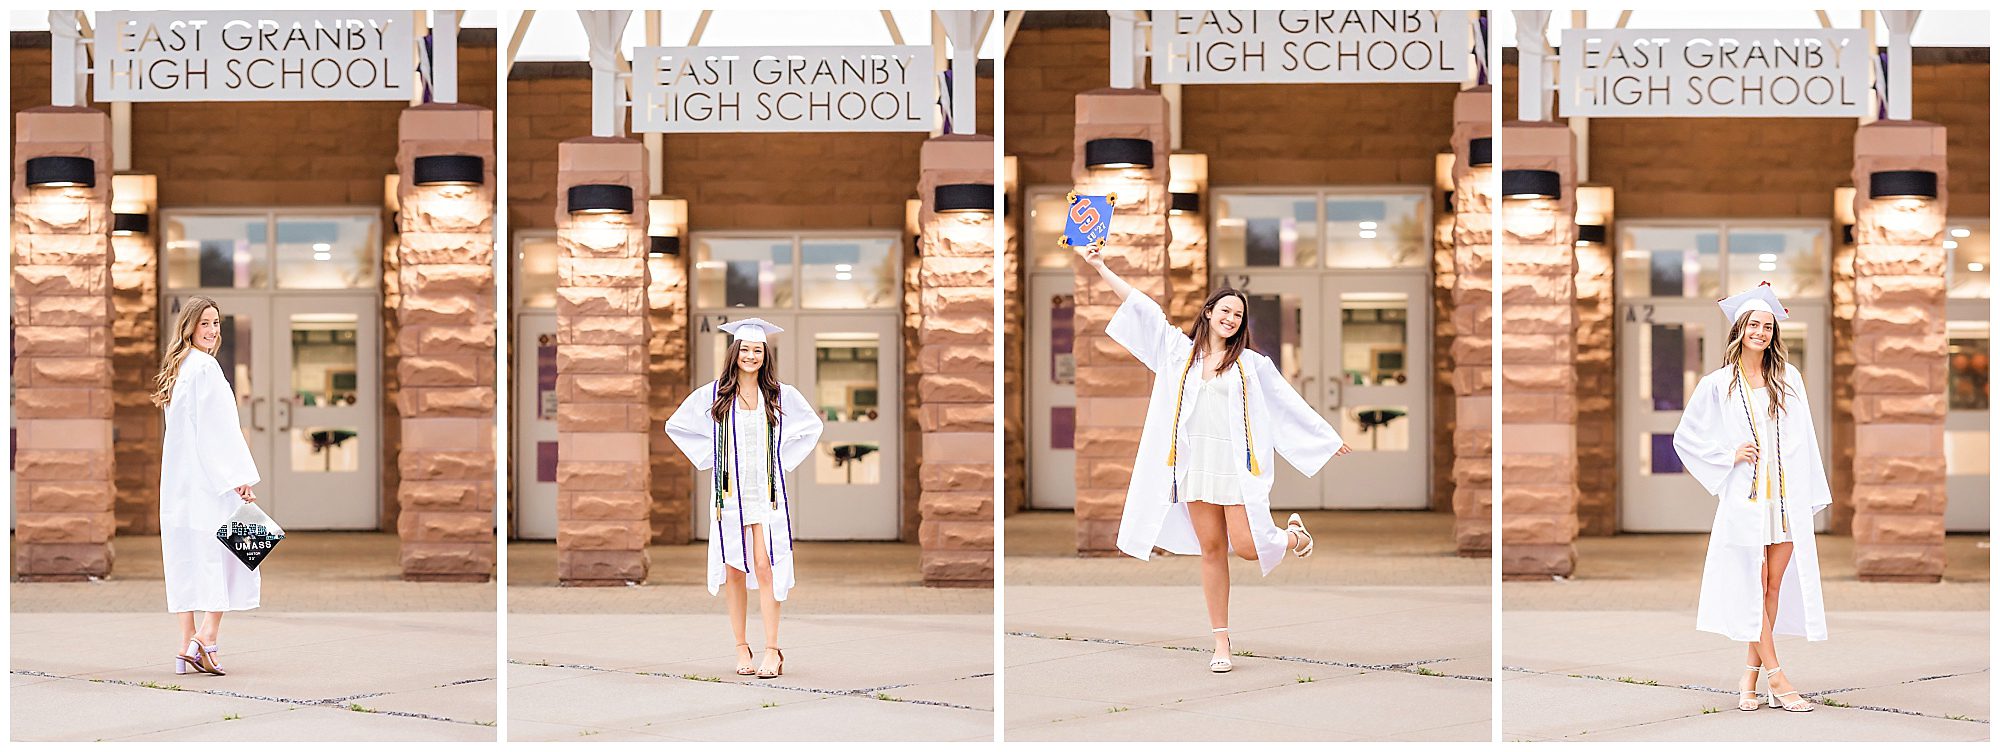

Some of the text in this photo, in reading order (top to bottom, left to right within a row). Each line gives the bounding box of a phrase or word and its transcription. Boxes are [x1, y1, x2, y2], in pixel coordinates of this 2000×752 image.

[116, 19, 393, 52] EAST GRANBY
[1174, 10, 1442, 34] EAST GRANBY
[1167, 40, 1455, 73] HIGH SCHOOL
[1582, 37, 1850, 69] EAST GRANBY
[109, 58, 400, 90] HIGH SCHOOL
[655, 55, 915, 86] EAST GRANBY
[1574, 75, 1856, 106] HIGH SCHOOL
[647, 91, 921, 122] HIGH SCHOOL
[1070, 198, 1101, 234] S
[235, 540, 272, 551] UMASS
